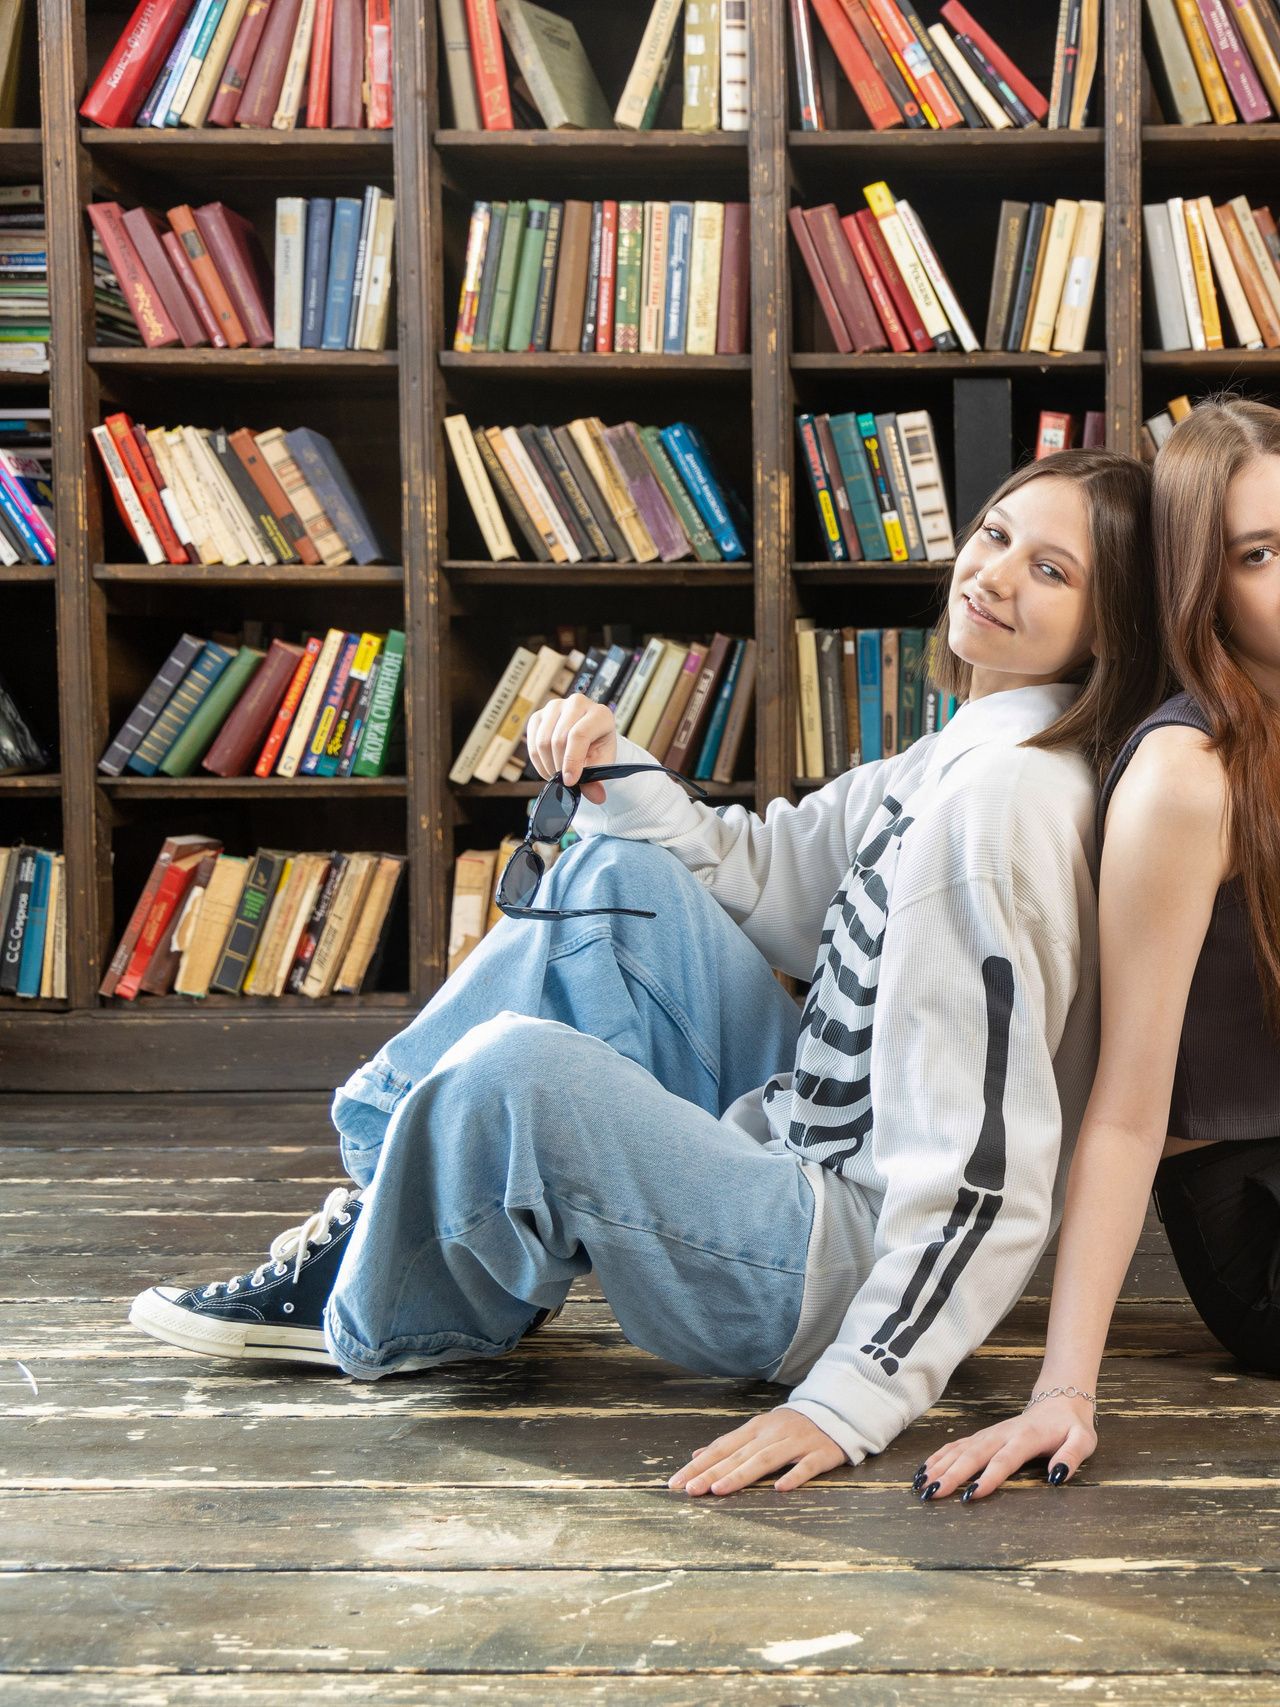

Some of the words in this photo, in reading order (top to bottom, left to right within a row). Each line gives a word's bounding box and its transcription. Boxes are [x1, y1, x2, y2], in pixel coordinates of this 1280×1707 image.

[125, 0, 157, 50] ФЕДИН
[8, 455, 42, 473] OSHO
[370, 650, 403, 720] СИМЕНОН
[507, 658, 526, 685] ГОСТИ
[360, 718, 388, 764] ЖОРЖ
